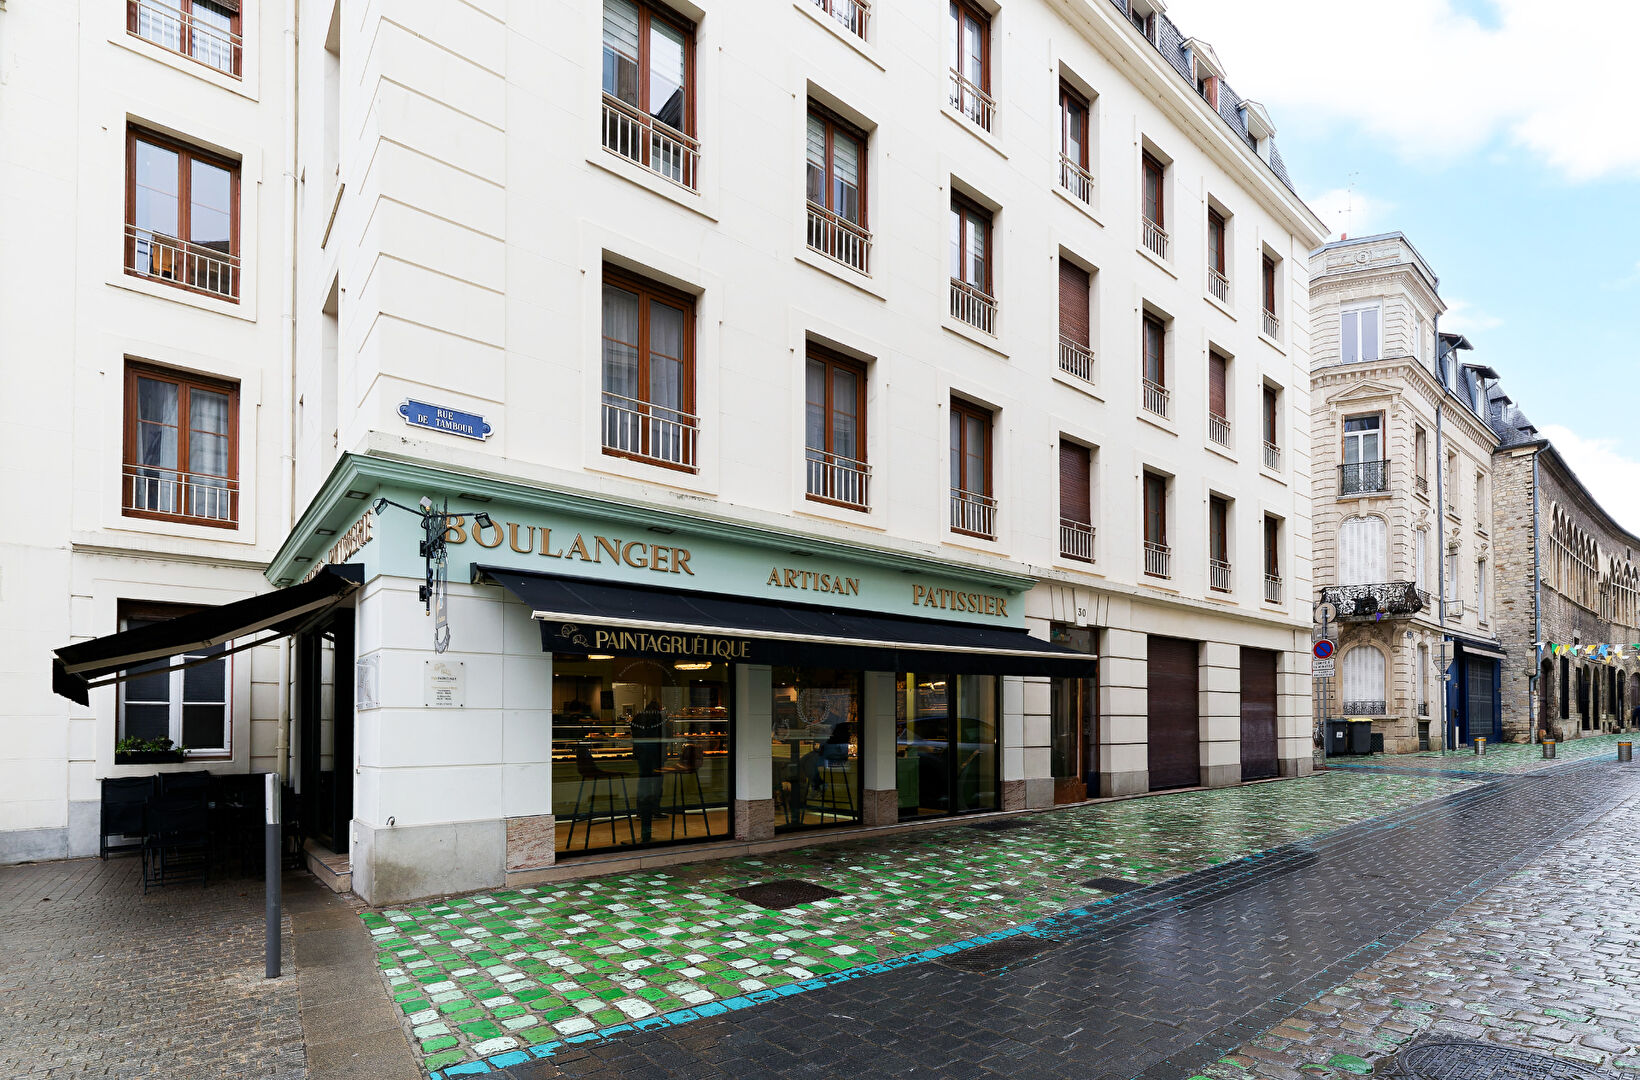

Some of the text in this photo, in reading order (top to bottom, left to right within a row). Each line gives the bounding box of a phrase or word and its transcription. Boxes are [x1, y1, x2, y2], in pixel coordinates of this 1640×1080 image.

[418, 414, 473, 434] DE TAMBOUR
[437, 409, 453, 420] RUE
[441, 512, 695, 576] BOULANGER
[766, 567, 860, 596] ARTISAN
[912, 584, 1009, 618] PATISSIER
[1077, 607, 1087, 617] 30
[595, 630, 752, 660] PAINTAGRUÉLIQUE
